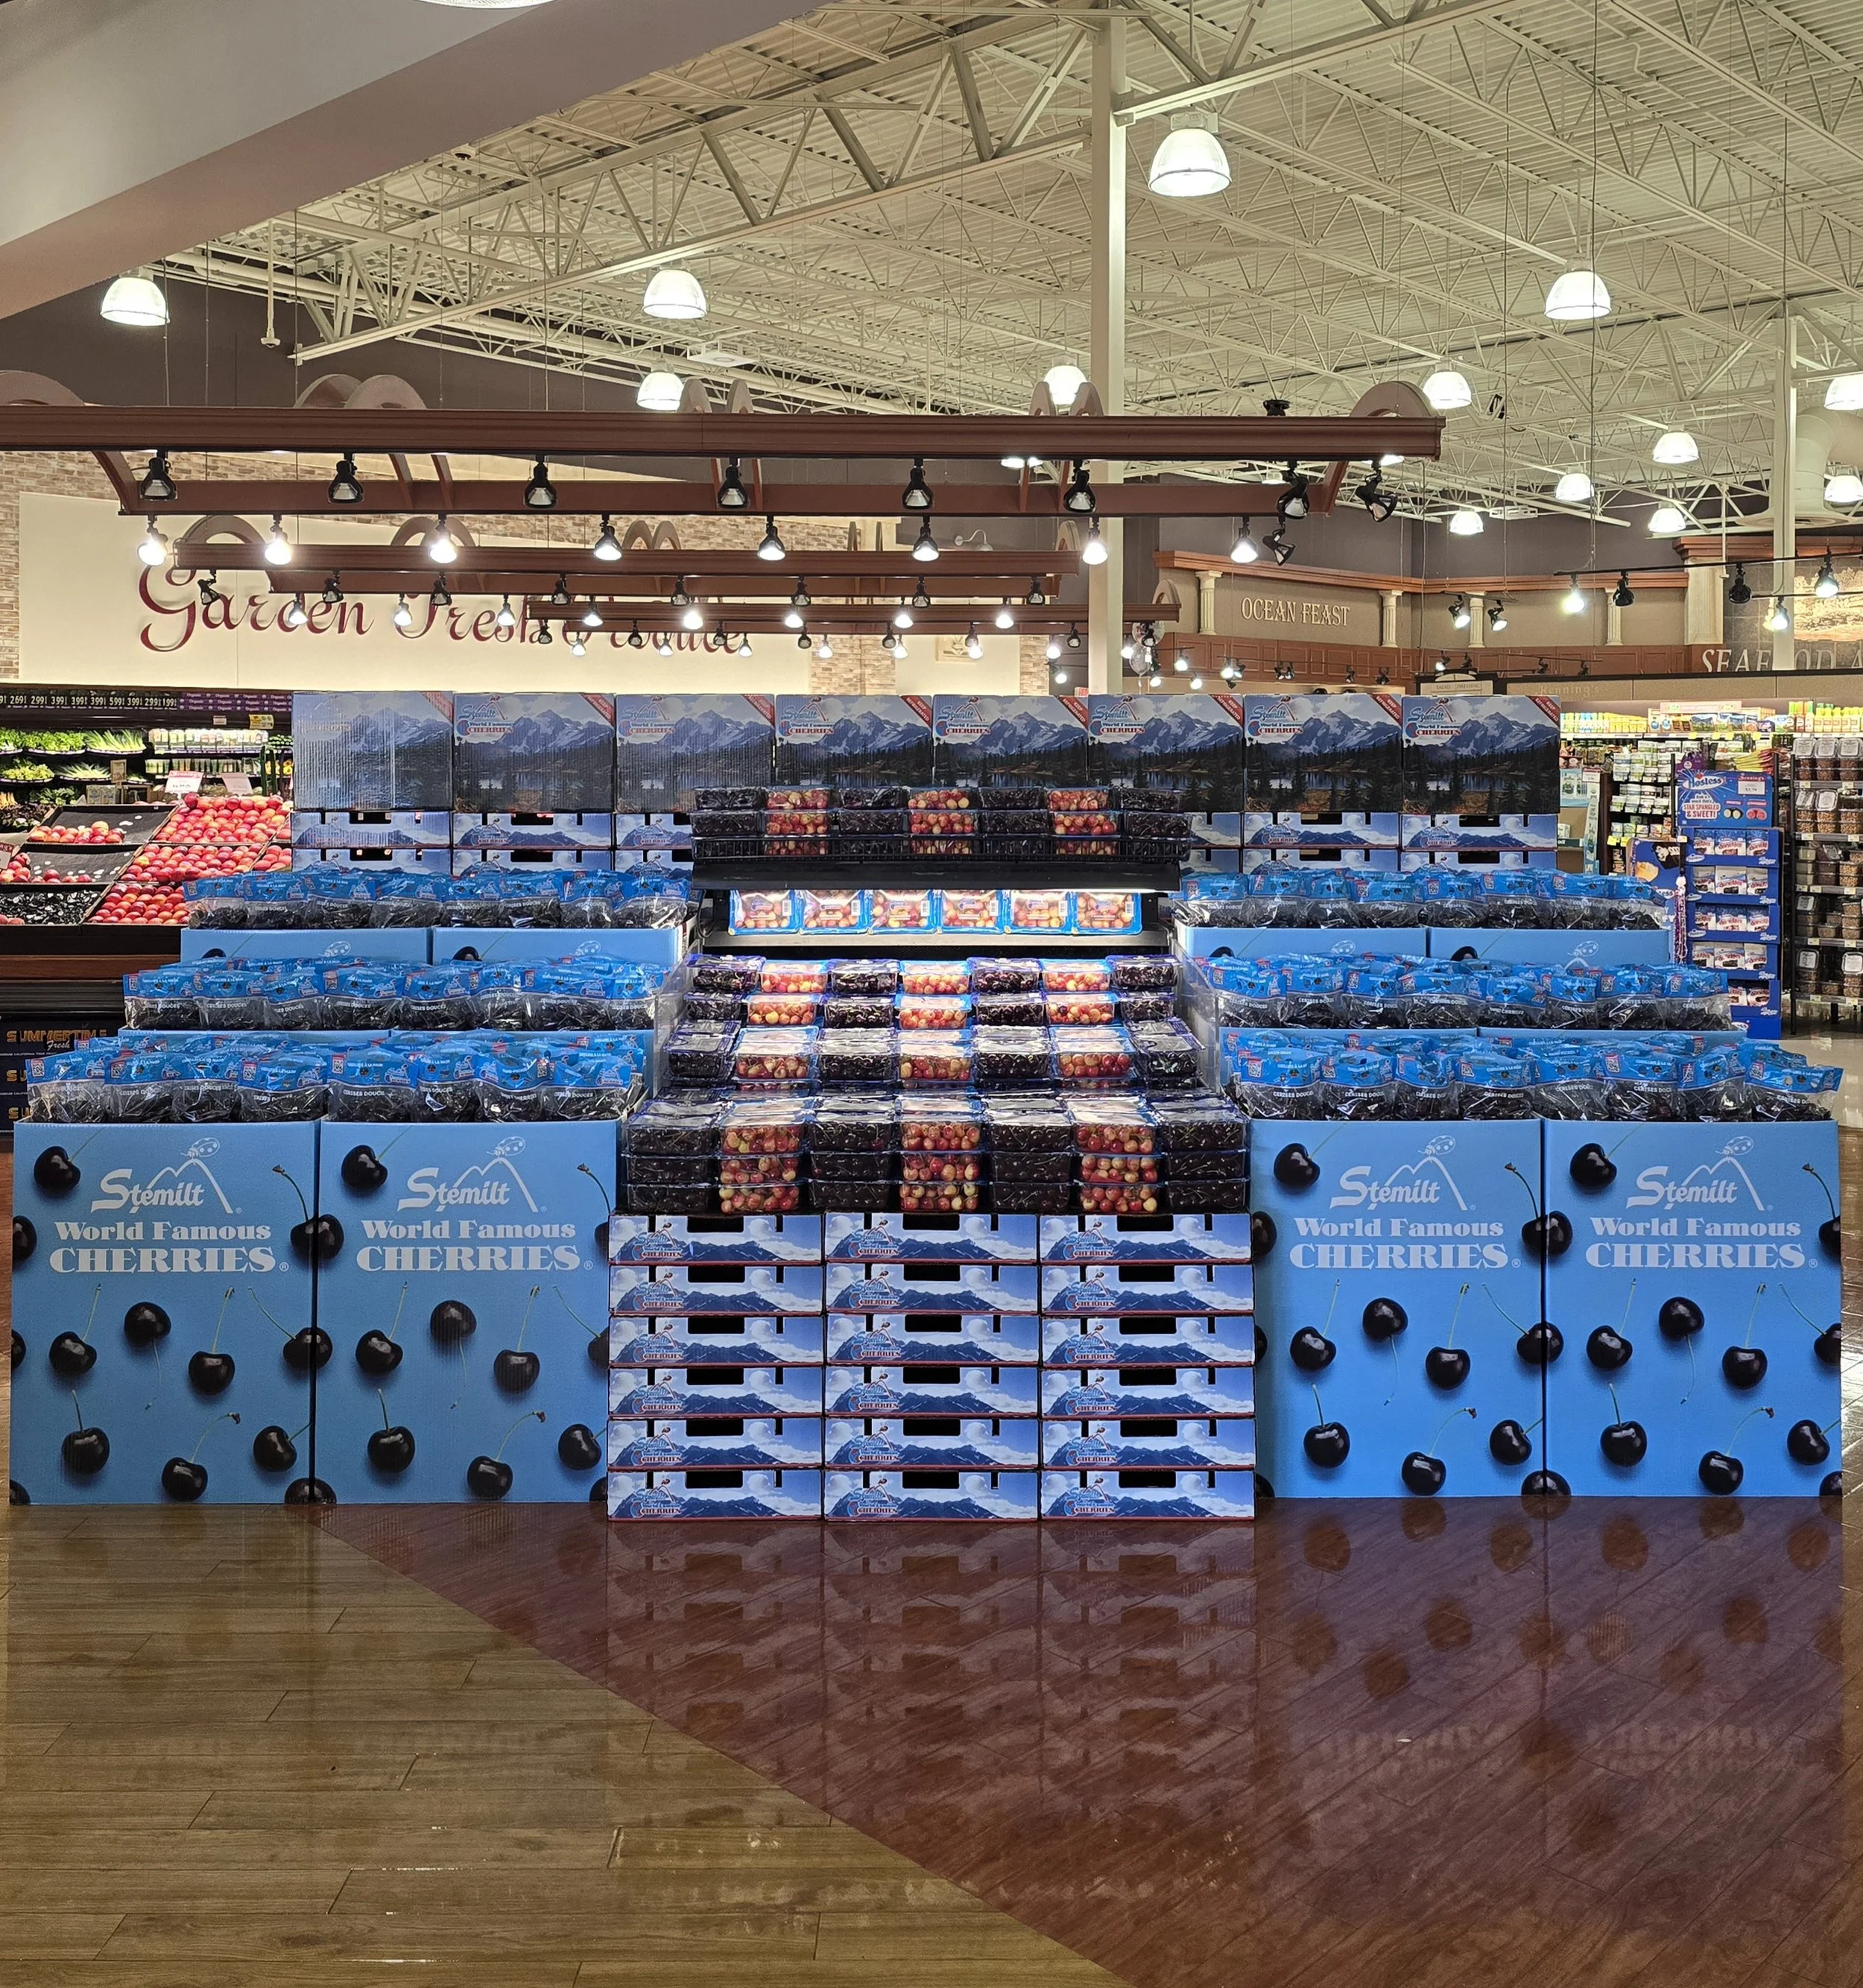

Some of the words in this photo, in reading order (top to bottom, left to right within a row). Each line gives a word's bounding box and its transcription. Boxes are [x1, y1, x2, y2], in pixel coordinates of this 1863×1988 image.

[1242, 597, 1296, 623] OCEAN
[1302, 602, 1350, 626] FEAST
[1702, 648, 1837, 672] SEAFOD
[1688, 775, 1722, 788] Hostess
[46, 1040, 71, 1051] Fresh
[91, 1168, 204, 1213] Stemilt
[398, 1168, 510, 1212] Stemilt
[1330, 1165, 1440, 1211] Stemilt
[1627, 1165, 1737, 1211] Stemilt
[55, 1221, 142, 1240] World
[152, 1221, 271, 1240] Famous
[362, 1220, 449, 1239] World
[458, 1220, 575, 1239] Famous
[1294, 1218, 1381, 1237] World
[1391, 1218, 1503, 1237] Famous
[1590, 1218, 1677, 1236] World
[1686, 1218, 1800, 1236] Famous
[50, 1247, 276, 1273] CHERRIES
[356, 1246, 580, 1271] CHERRIES
[1290, 1244, 1507, 1269] CHERRIES
[1586, 1244, 1804, 1268] CHERRIES
